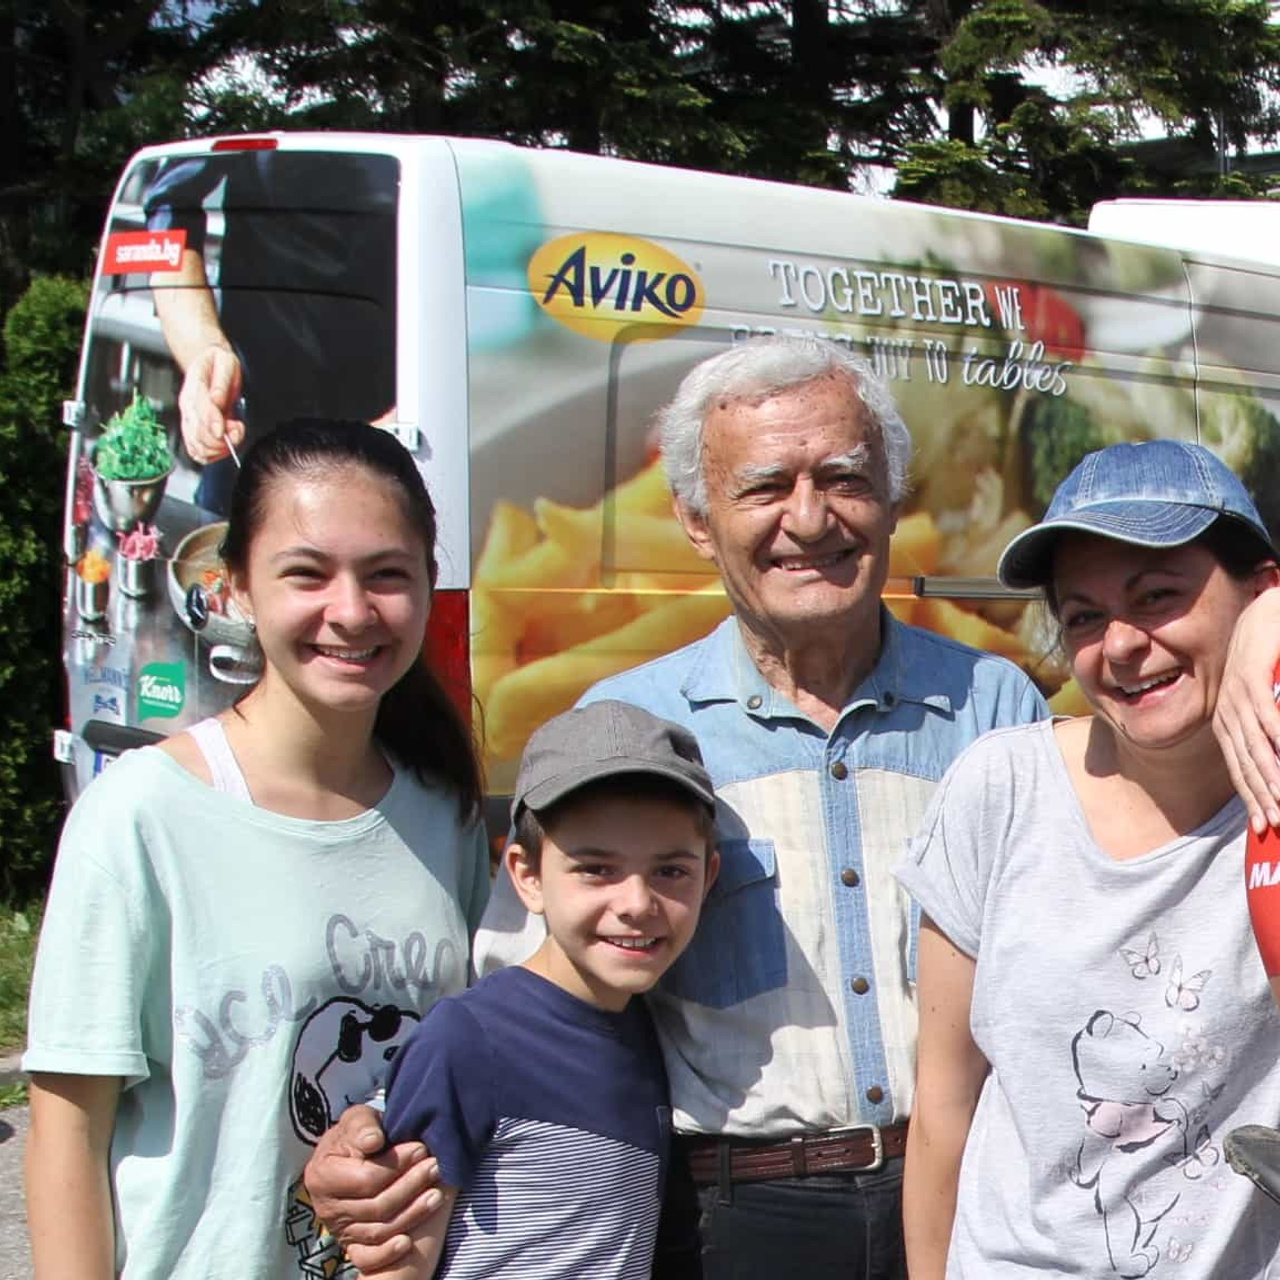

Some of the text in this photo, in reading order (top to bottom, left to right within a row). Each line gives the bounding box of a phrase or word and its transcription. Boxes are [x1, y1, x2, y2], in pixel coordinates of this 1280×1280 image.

[768, 258, 1026, 331] TOGETHER WE
[924, 338, 949, 384] TO
[962, 339, 1074, 397] tables
